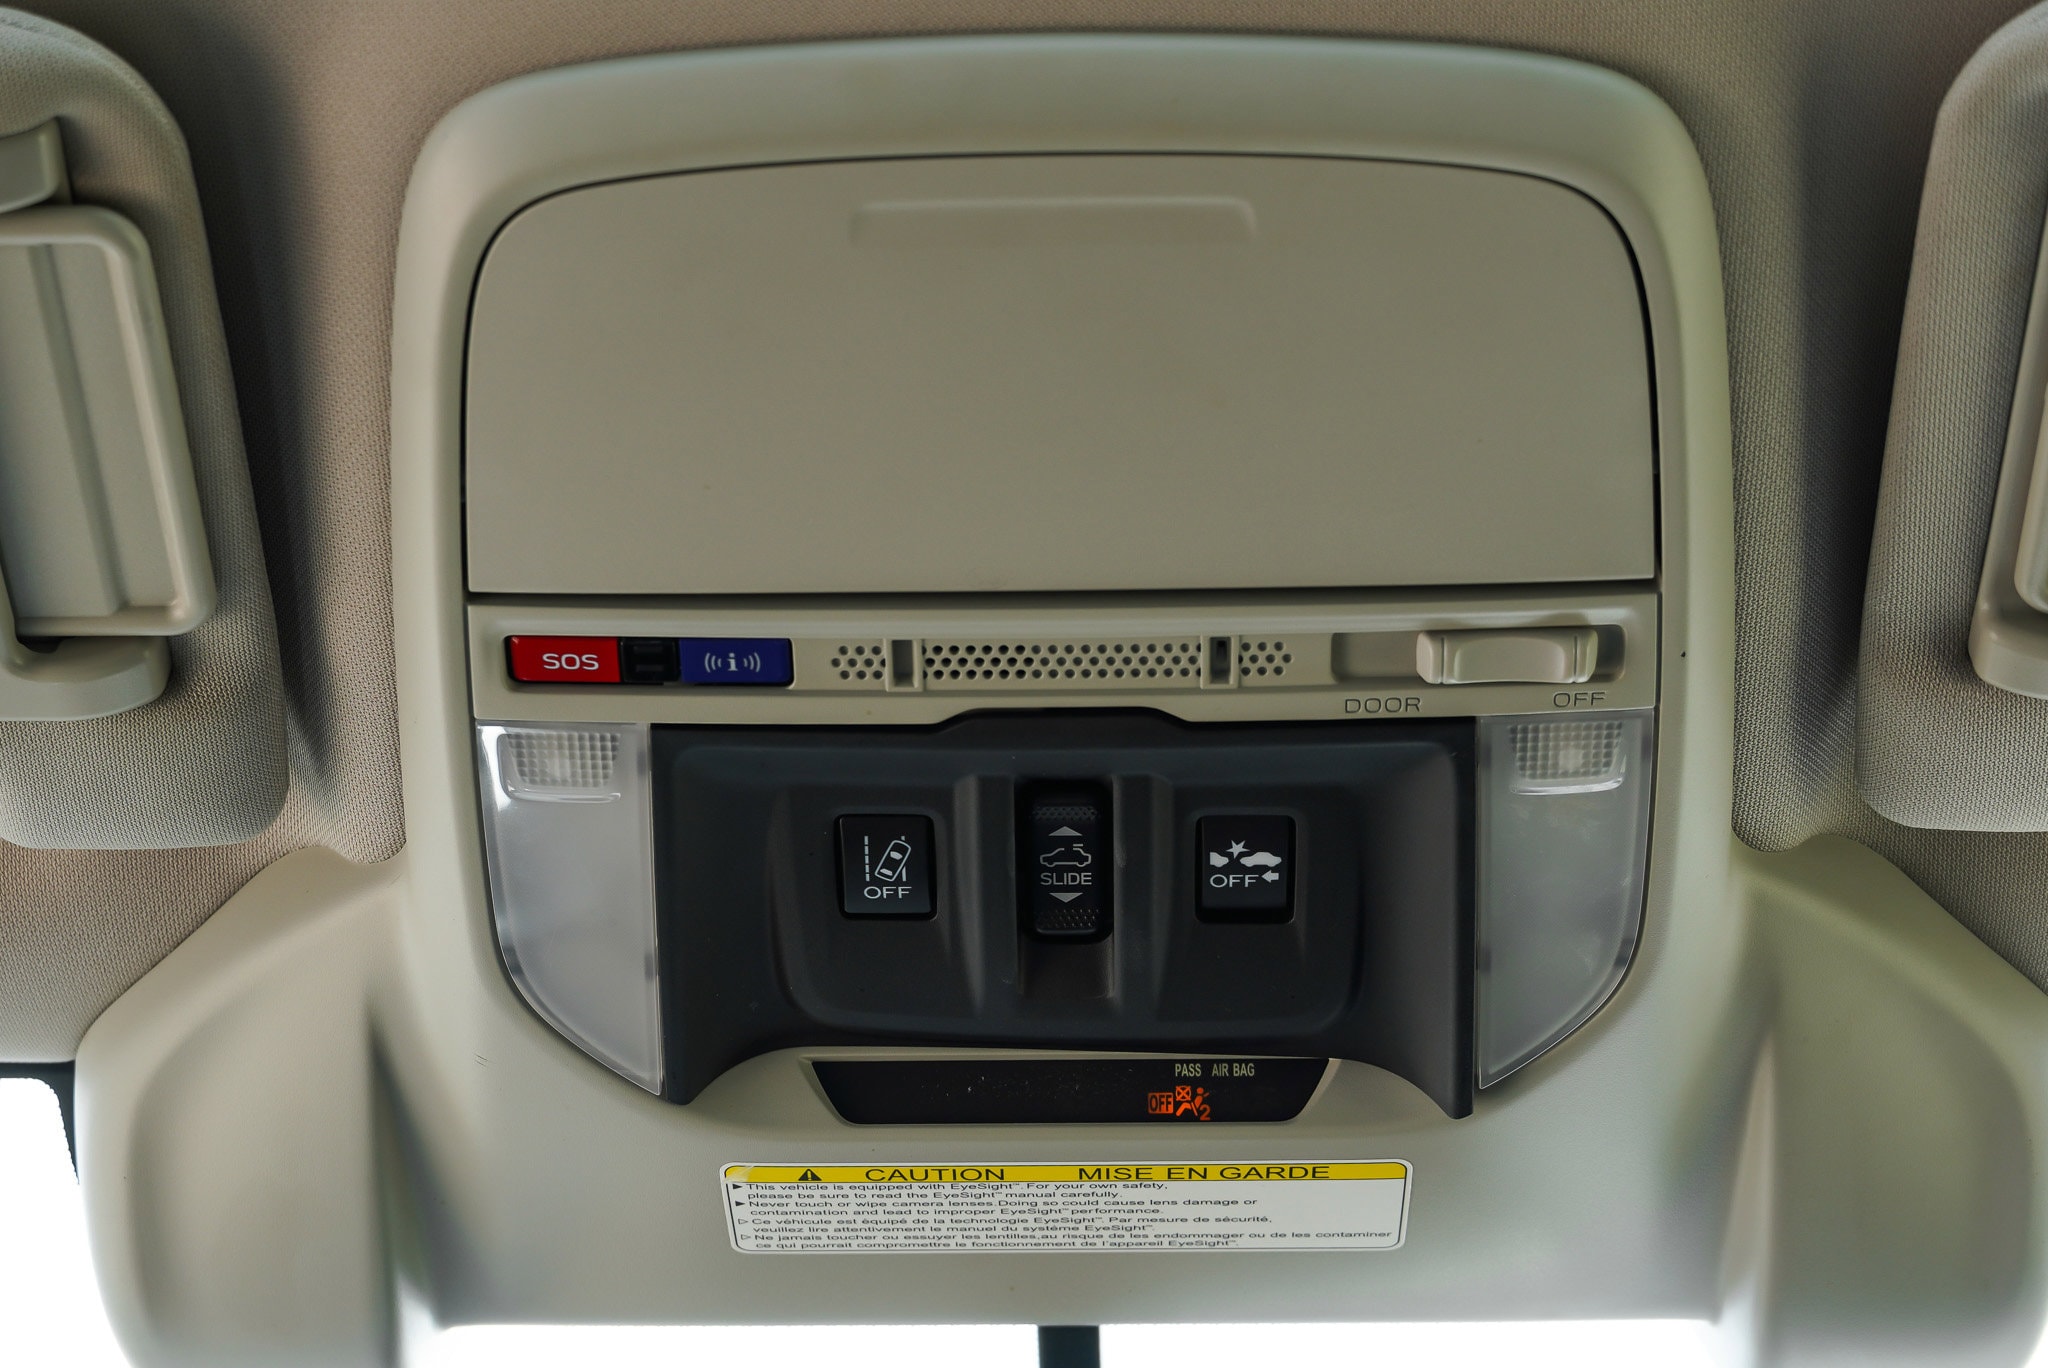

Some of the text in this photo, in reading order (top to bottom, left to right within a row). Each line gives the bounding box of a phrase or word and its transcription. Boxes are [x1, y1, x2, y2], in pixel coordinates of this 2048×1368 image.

[542, 653, 599, 670] SOS
[1344, 697, 1421, 714] DOOR
[1553, 691, 1606, 708] OFF
[1040, 872, 1092, 886] SLIDE
[1210, 874, 1256, 888] OFF
[864, 886, 912, 899] OFF
[1175, 1063, 1255, 1077] PASS AIR BAG
[1149, 1094, 1171, 1112] OFF
[865, 1168, 1005, 1181] CAUTION
[1079, 1166, 1330, 1180] MISE EN GARDE
[1122, 1182, 1168, 1190] safety,
[776, 1242, 796, 1250] qui
[801, 1242, 853, 1250] pourrait
